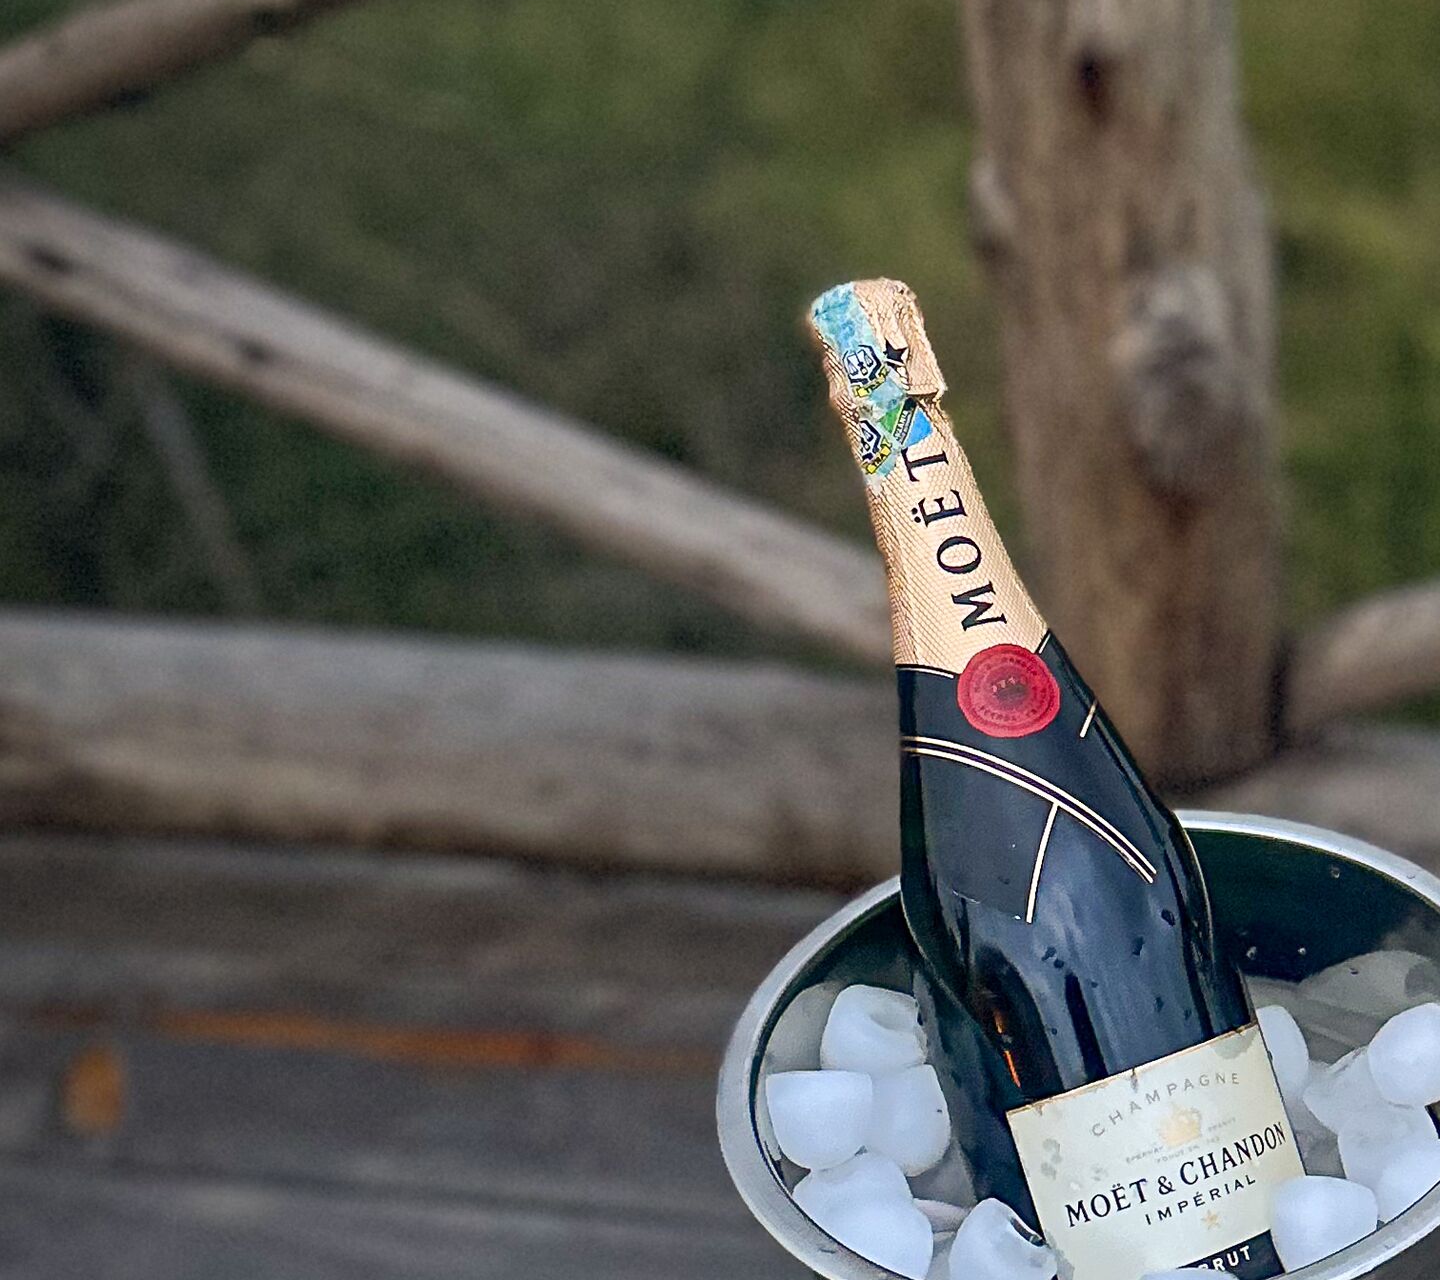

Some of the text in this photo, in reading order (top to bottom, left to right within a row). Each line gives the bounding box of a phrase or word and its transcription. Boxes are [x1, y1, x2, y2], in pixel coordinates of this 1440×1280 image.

[901, 448, 1007, 632] MOËT
[1091, 1071, 1240, 1137] CHAMPAGNE
[1064, 1177, 1149, 1228] MOËT
[1157, 1175, 1176, 1196] &
[1179, 1120, 1287, 1186] CHANDON
[1144, 1174, 1257, 1226] IMPÉRIAL
